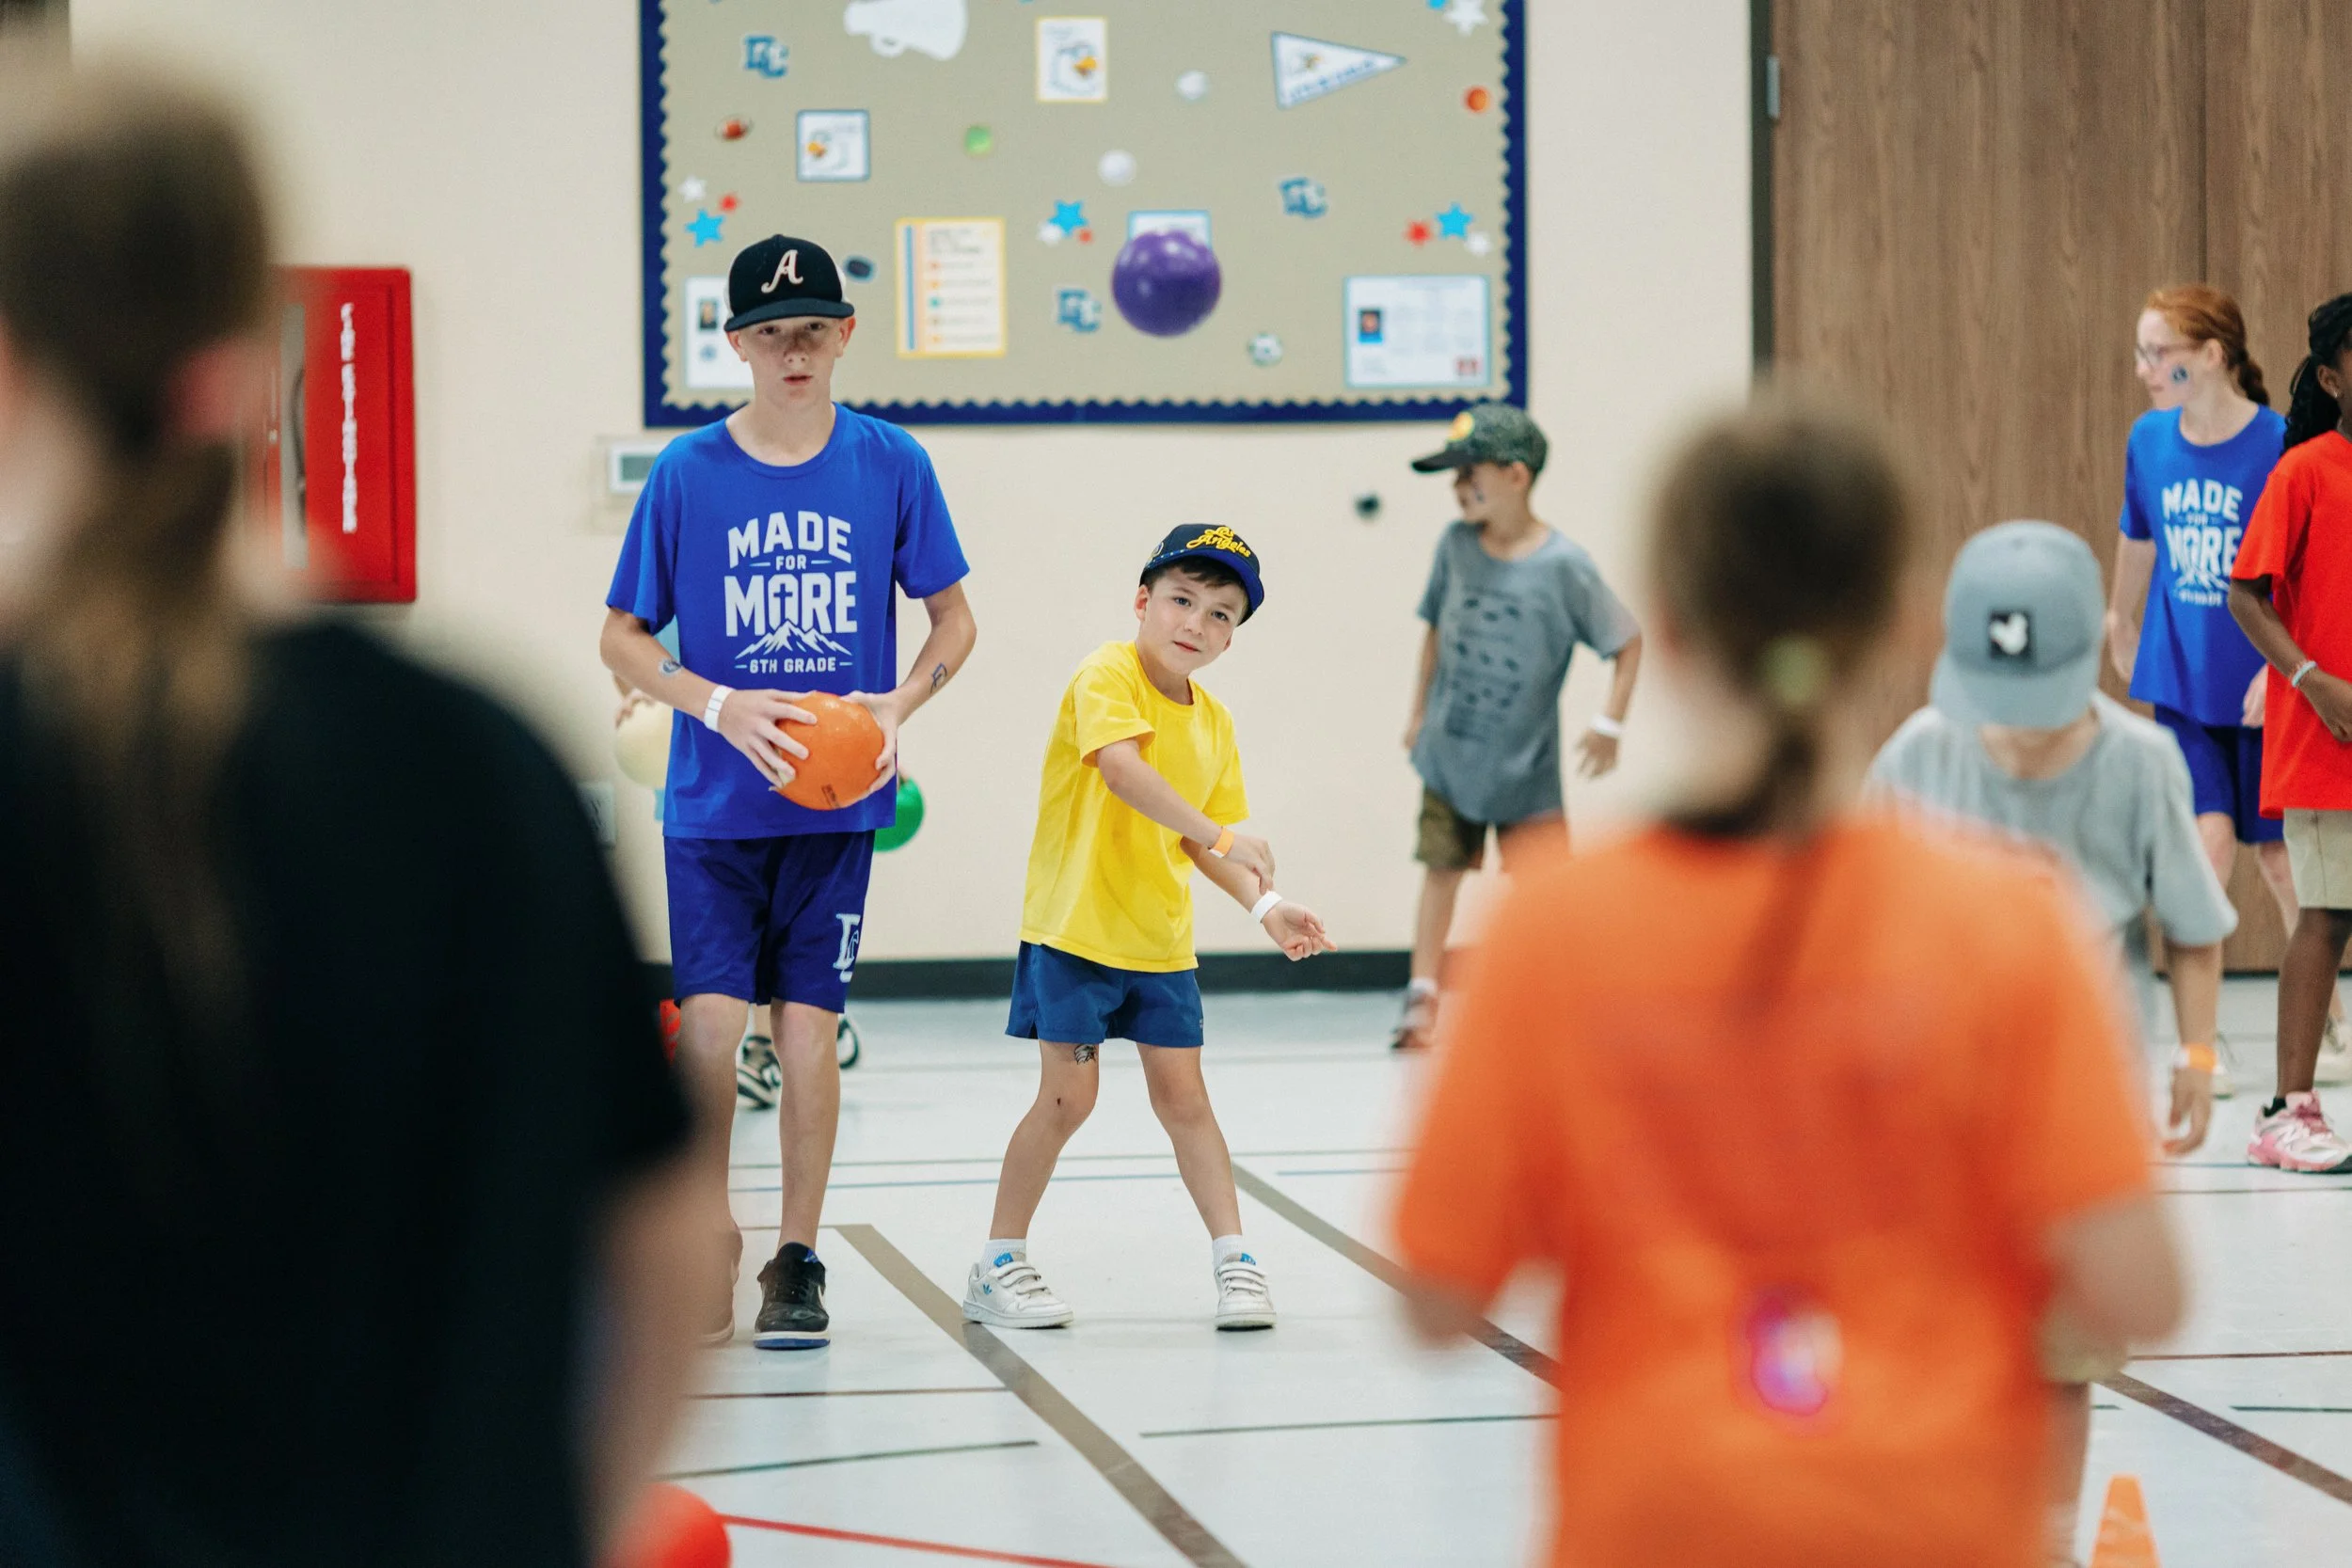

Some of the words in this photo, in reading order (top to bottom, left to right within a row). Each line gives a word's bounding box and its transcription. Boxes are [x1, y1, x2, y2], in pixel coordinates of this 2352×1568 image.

[761, 249, 803, 293] A
[2162, 478, 2243, 523] MADE
[728, 511, 851, 569] MADE
[1186, 533, 1251, 558] Angeles
[1205, 527, 1234, 540] Los
[2165, 524, 2242, 577] MORE
[775, 554, 806, 571] FOR
[723, 571, 857, 637] MORE
[750, 658, 778, 673] 6TH
[784, 657, 836, 673] GRADE
